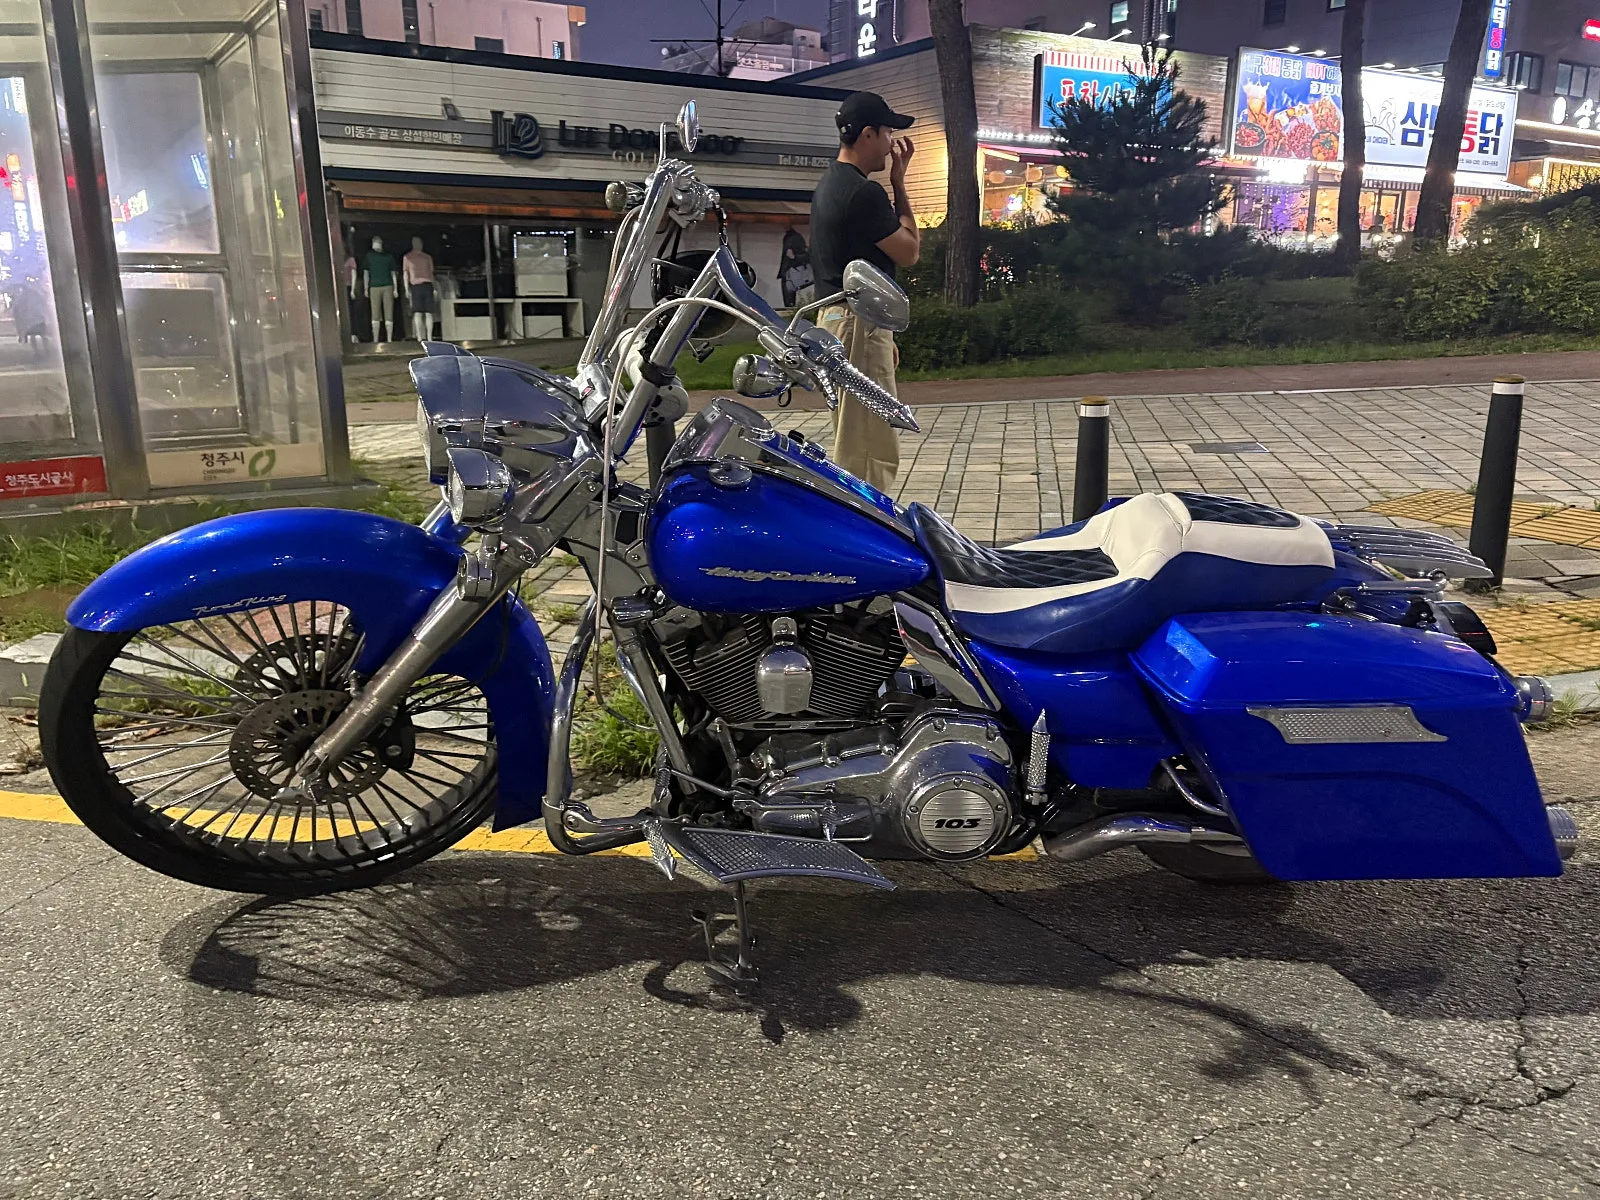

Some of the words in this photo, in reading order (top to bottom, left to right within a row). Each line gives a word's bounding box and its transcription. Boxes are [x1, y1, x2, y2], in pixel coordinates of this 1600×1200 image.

[344, 125, 377, 139] 이동수
[378, 128, 401, 141] 골프
[402, 130, 463, 145] 상설할인매장
[200, 451, 245, 468] 청주시
[5, 471, 74, 487] 청주도시공사
[935, 818, 981, 829] 103
